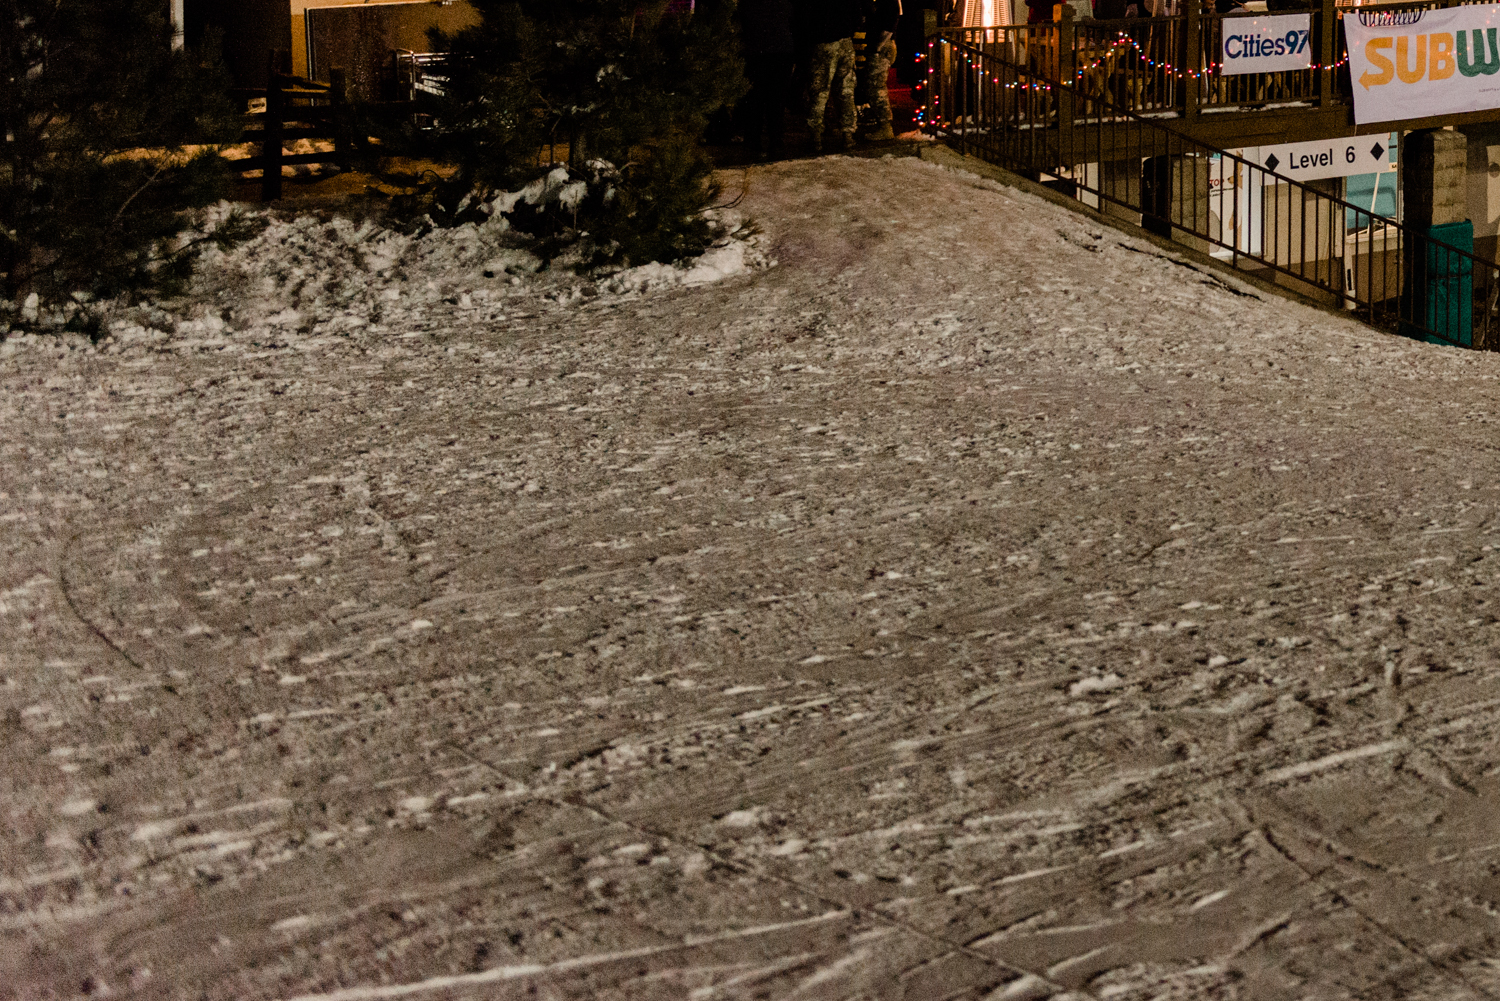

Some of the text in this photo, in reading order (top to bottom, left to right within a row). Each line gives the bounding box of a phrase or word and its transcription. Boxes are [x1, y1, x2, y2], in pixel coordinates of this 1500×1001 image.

[1225, 30, 1309, 59] Cities97
[1289, 146, 1356, 170] Level 6
